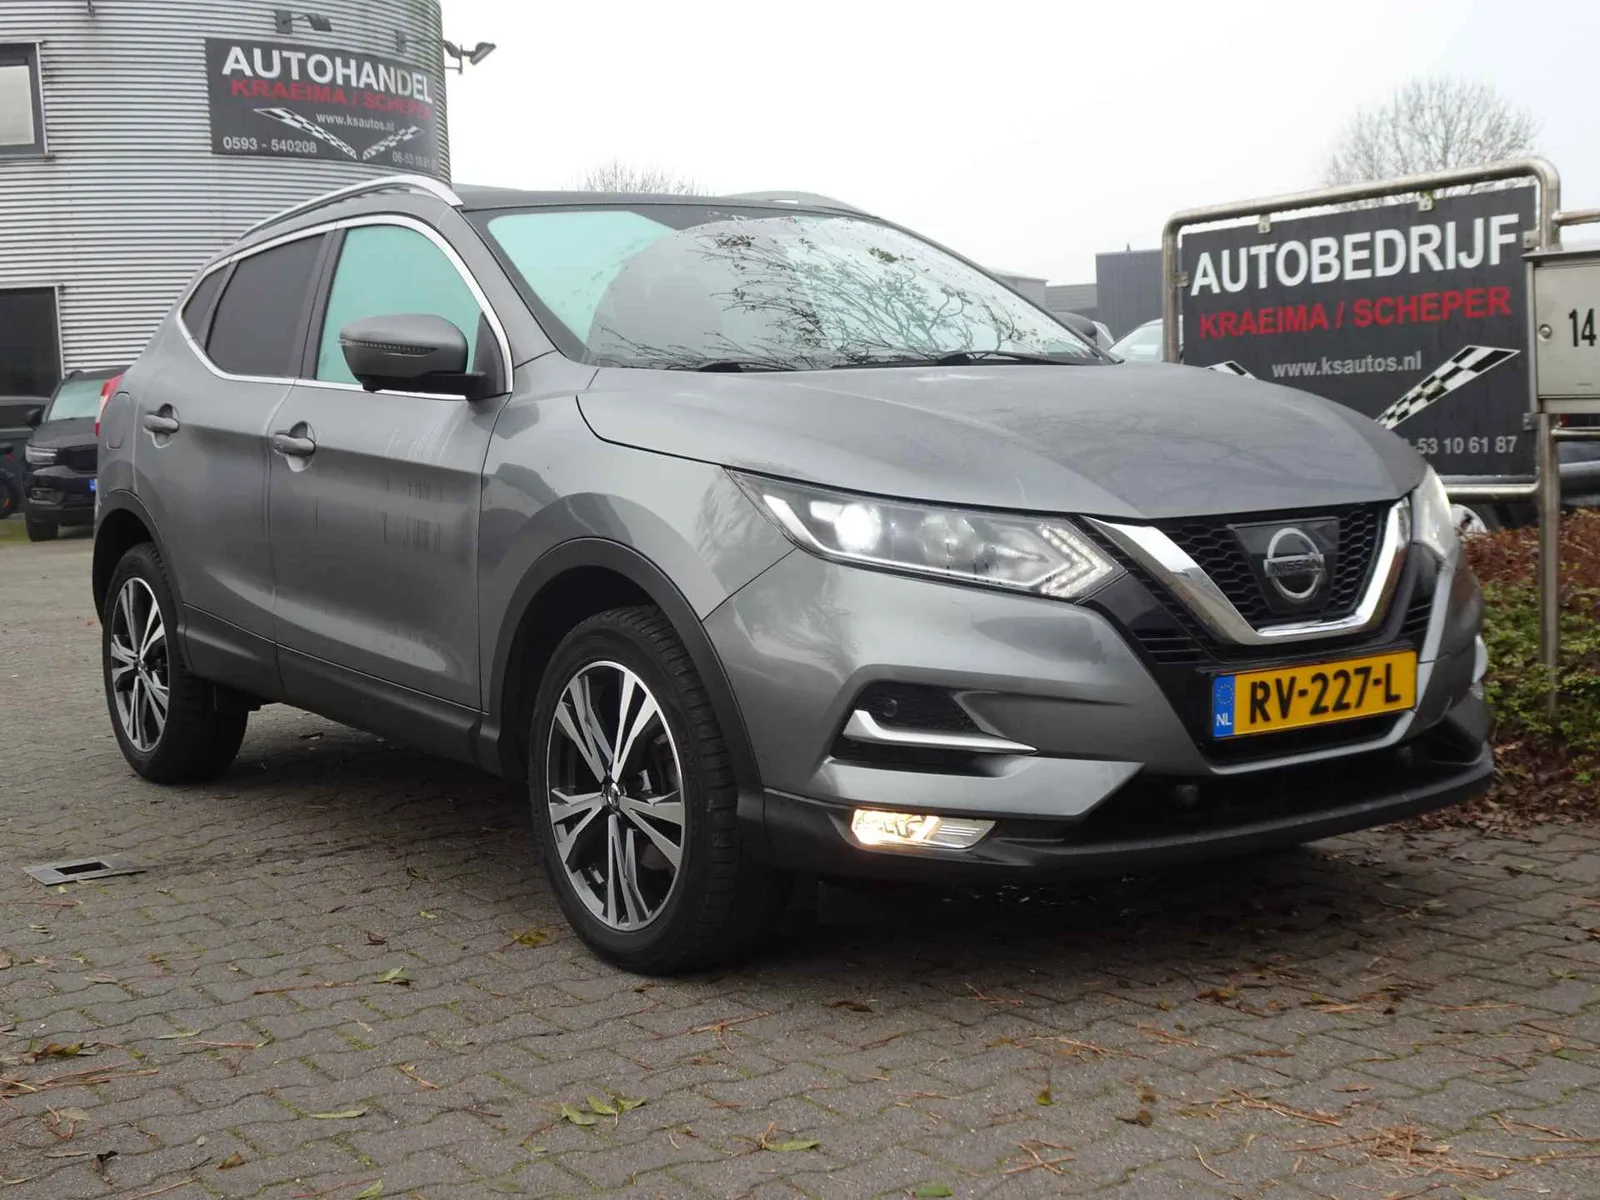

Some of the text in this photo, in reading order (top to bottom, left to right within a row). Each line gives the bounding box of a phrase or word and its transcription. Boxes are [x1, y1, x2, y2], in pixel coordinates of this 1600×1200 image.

[222, 46, 432, 103] AUTOHANDEL
[231, 79, 347, 106] KRAEIMA
[316, 112, 394, 131] www.ksautos.nl
[223, 136, 258, 150] 0593
[271, 138, 317, 154] 540208
[1190, 213, 1519, 296] AUTOBEDRIJF
[1200, 303, 1327, 340] KRAEIMA
[1352, 287, 1511, 328] SCHEPER
[1568, 308, 1597, 347] 14
[1272, 350, 1422, 378] www.ksautos.nl
[1443, 437, 1464, 454] 10
[1469, 436, 1489, 454] 61
[1495, 435, 1518, 453] 87
[1250, 663, 1401, 724] RV-227-L
[1216, 712, 1232, 727] NL
